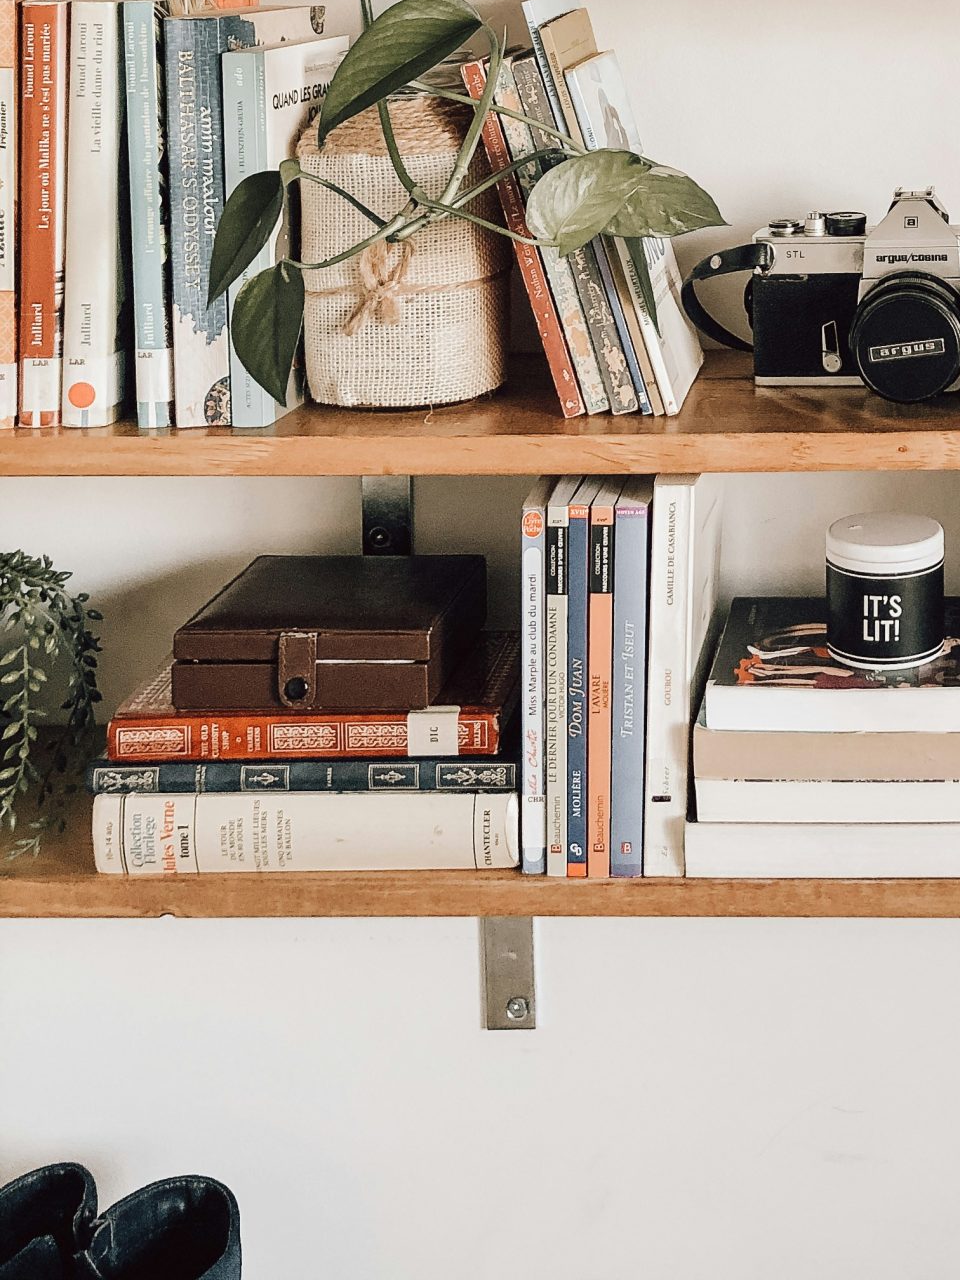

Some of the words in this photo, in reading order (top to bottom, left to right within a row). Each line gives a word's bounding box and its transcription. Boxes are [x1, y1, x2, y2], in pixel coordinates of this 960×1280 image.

[39, 22, 51, 64] mariée
[92, 22, 103, 47] riad
[92, 65, 103, 98] dame
[273, 90, 299, 109] QUAND
[90, 99, 102, 136] vieille
[39, 134, 50, 170] Malika
[182, 197, 200, 290] ODYSSEY
[785, 250, 806, 259] STL
[875, 252, 949, 263] argus/cosina
[880, 342, 936, 357] argus
[667, 500, 676, 554] CASABIANCA
[528, 572, 536, 602] mardi
[666, 566, 674, 607] CAMILLE
[528, 618, 536, 640] club
[863, 619, 900, 641] LIT!
[528, 657, 538, 693] Marple
[528, 694, 536, 716] Miss
[570, 769, 582, 818] MOLIÈRE
[180, 835, 189, 860] tome
